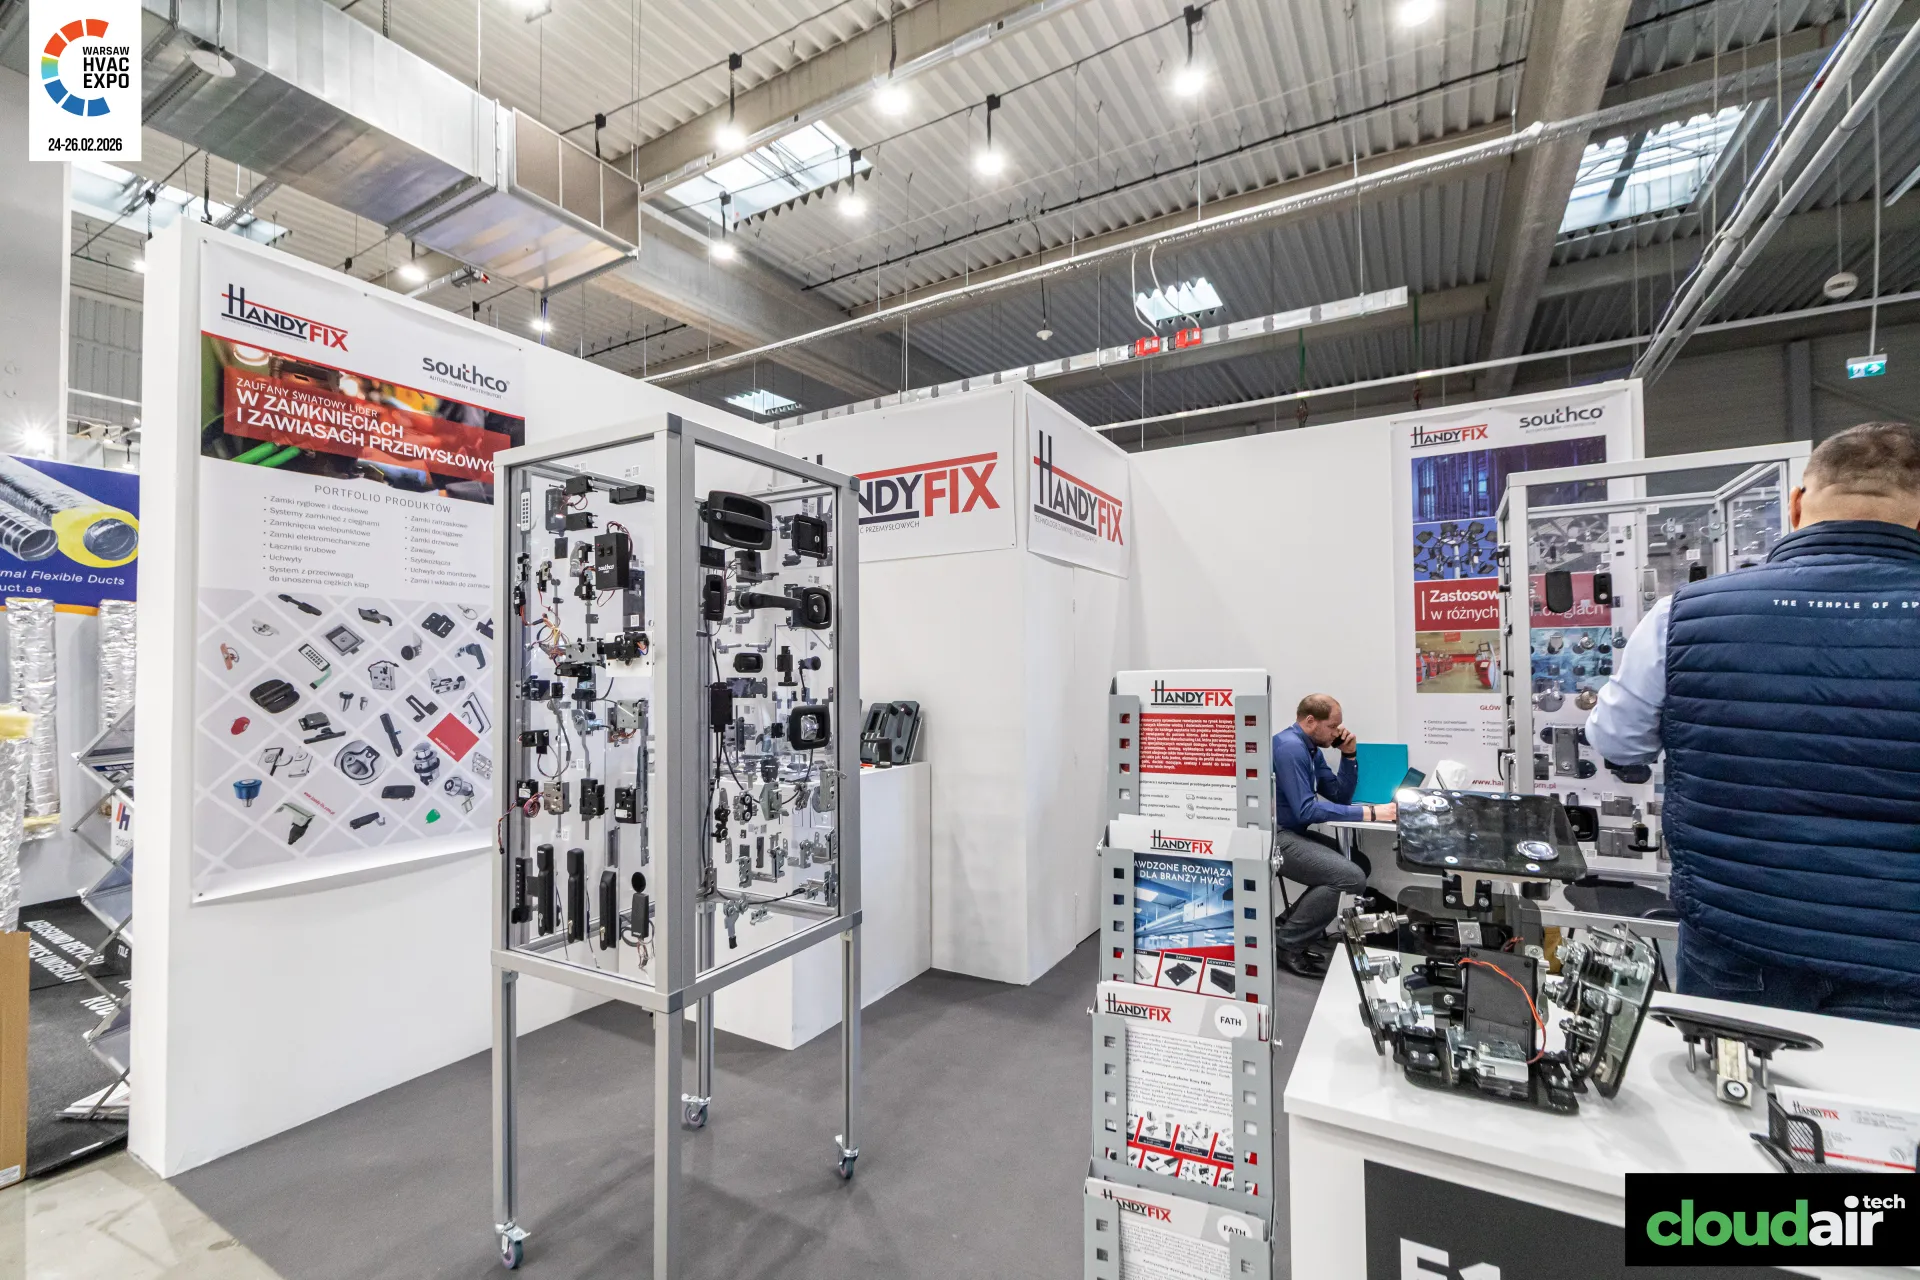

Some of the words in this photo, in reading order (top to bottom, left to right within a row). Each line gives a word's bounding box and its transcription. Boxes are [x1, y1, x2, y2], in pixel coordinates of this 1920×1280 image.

[225, 283, 349, 352] HANDYFIX
[422, 357, 509, 393] southco
[236, 377, 289, 397] ZAUFANY
[292, 390, 347, 410] ŚWIATOWY
[350, 404, 378, 418] LIDER
[236, 388, 258, 406] W
[263, 394, 404, 439] ZAMKNIĘCIACH
[1519, 405, 1604, 429] southco
[236, 406, 242, 422] I
[248, 409, 365, 447] ZAWIASACH
[1411, 424, 1488, 446] HANDYFIX
[1034, 430, 1124, 546] HANDYFIX
[270, 495, 295, 505] Zamki
[314, 484, 381, 503] PORTFOLIO
[385, 495, 451, 514] PRODUKTÓW
[269, 507, 303, 518] Systemy
[269, 530, 295, 540] Zamki
[865, 520, 920, 533] PRZEMYSŁOWYCH
[31, 570, 83, 583] Flexible
[87, 574, 125, 586] Ducts
[269, 565, 299, 575] System
[1430, 609, 1443, 620] w
[1446, 604, 1499, 622] różnych
[1773, 599, 1797, 607] THE
[1808, 600, 1860, 609] TEMPLE
[1872, 601, 1889, 609] OF
[1151, 680, 1234, 708] HANDYFIX
[1151, 829, 1214, 855] HANDYFIX
[1139, 870, 1158, 880] DLA
[1160, 871, 1197, 883] BRANŻY
[1200, 877, 1225, 886] HVAC
[1105, 992, 1172, 1023] HANDYFIX
[1220, 1015, 1242, 1027] FATH
[1792, 1100, 1840, 1121] HANDYFIX
[1223, 1224, 1246, 1237] FATH
